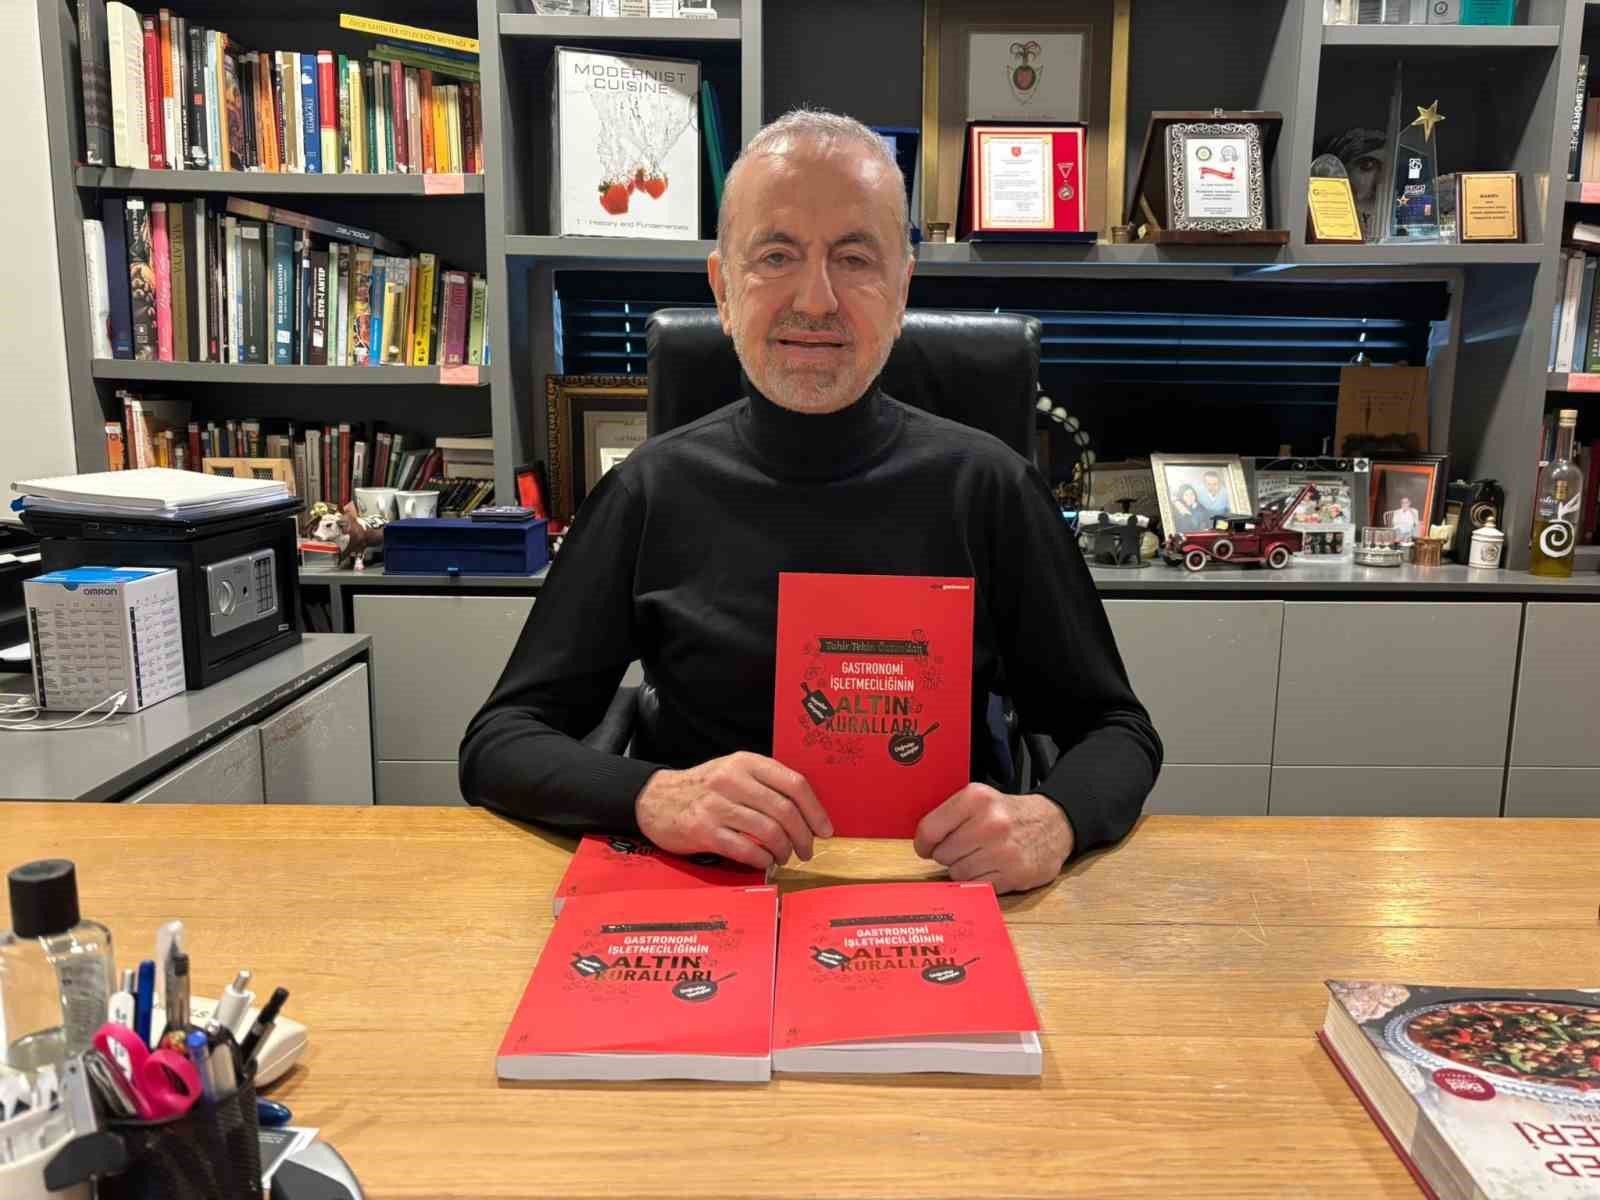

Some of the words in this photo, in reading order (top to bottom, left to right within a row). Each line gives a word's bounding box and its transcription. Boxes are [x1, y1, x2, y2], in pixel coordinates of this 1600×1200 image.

[574, 63, 687, 83] MODERNIST
[594, 78, 668, 94] CUISINE
[83, 588, 118, 596] OMRON
[841, 660, 904, 675] GASTRONOMİ
[830, 674, 915, 692] İŞLETMECİLİĞİNİN
[834, 695, 910, 716] ALTIN
[826, 715, 919, 736] KURALLARI
[857, 925, 929, 937] GASTRONOMİ
[624, 934, 698, 945] GASTRONOMİ
[608, 943, 709, 954] İŞLETMECİLİĞİNİN
[852, 946, 940, 959] ALTIN
[609, 956, 704, 969] ALTIN
[595, 969, 712, 982] KURALLARI
[1512, 1122, 1600, 1151] ERİ
